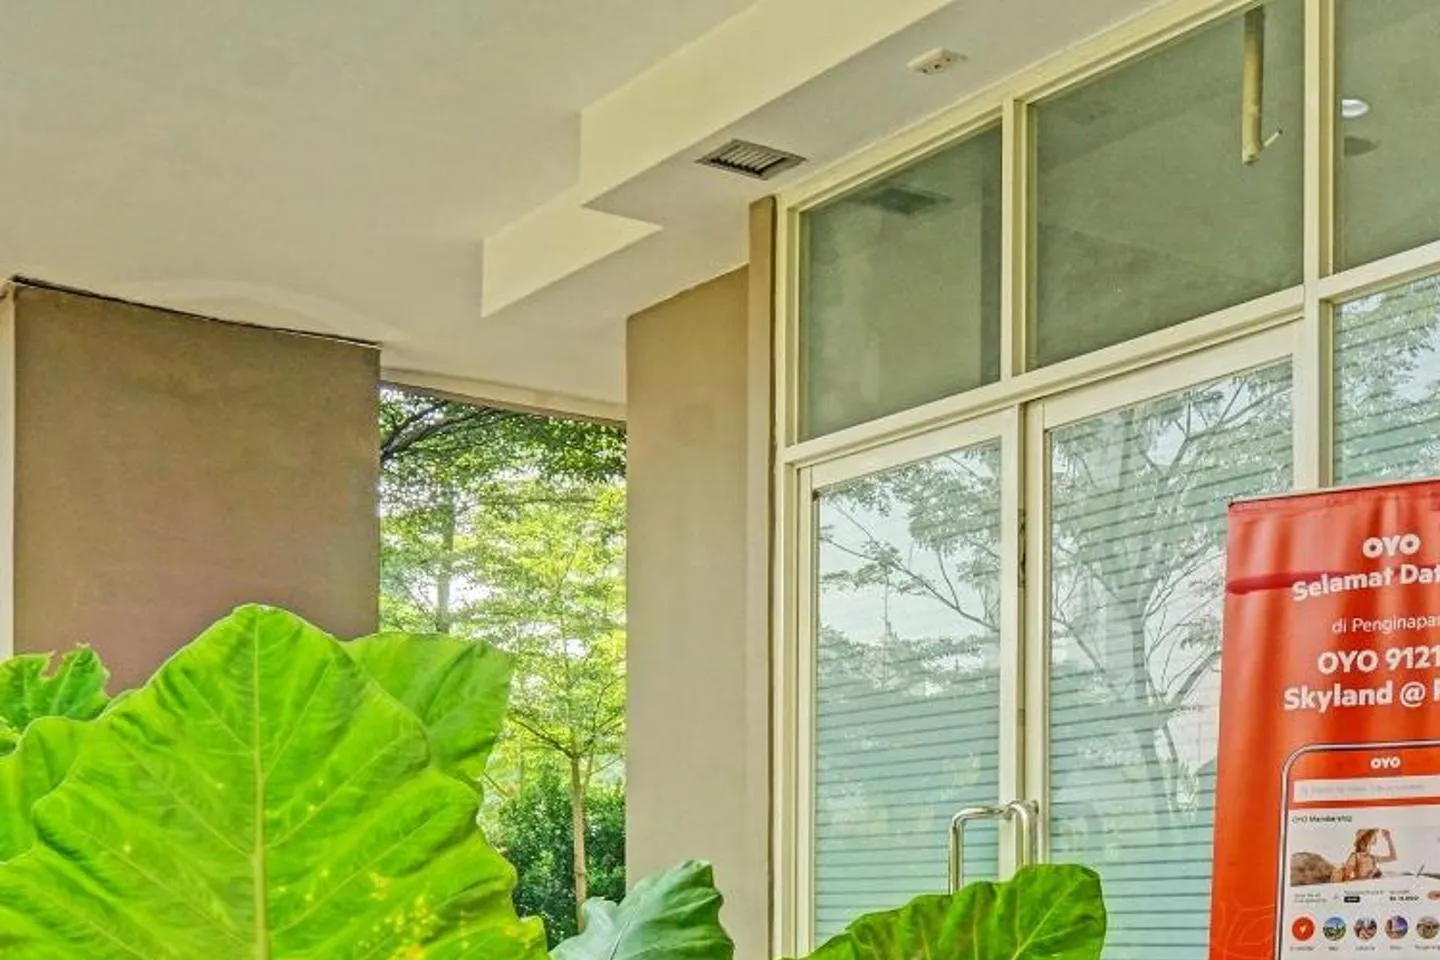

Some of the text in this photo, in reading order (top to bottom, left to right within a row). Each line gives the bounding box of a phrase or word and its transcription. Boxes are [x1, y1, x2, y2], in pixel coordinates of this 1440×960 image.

[1362, 533, 1421, 559] OYO
[1291, 567, 1393, 602] Selamat
[1332, 617, 1347, 634] di
[1317, 650, 1379, 675] OYO
[1283, 680, 1393, 712] Skyland
[1400, 682, 1425, 708] @
[1370, 756, 1400, 769] OYO
